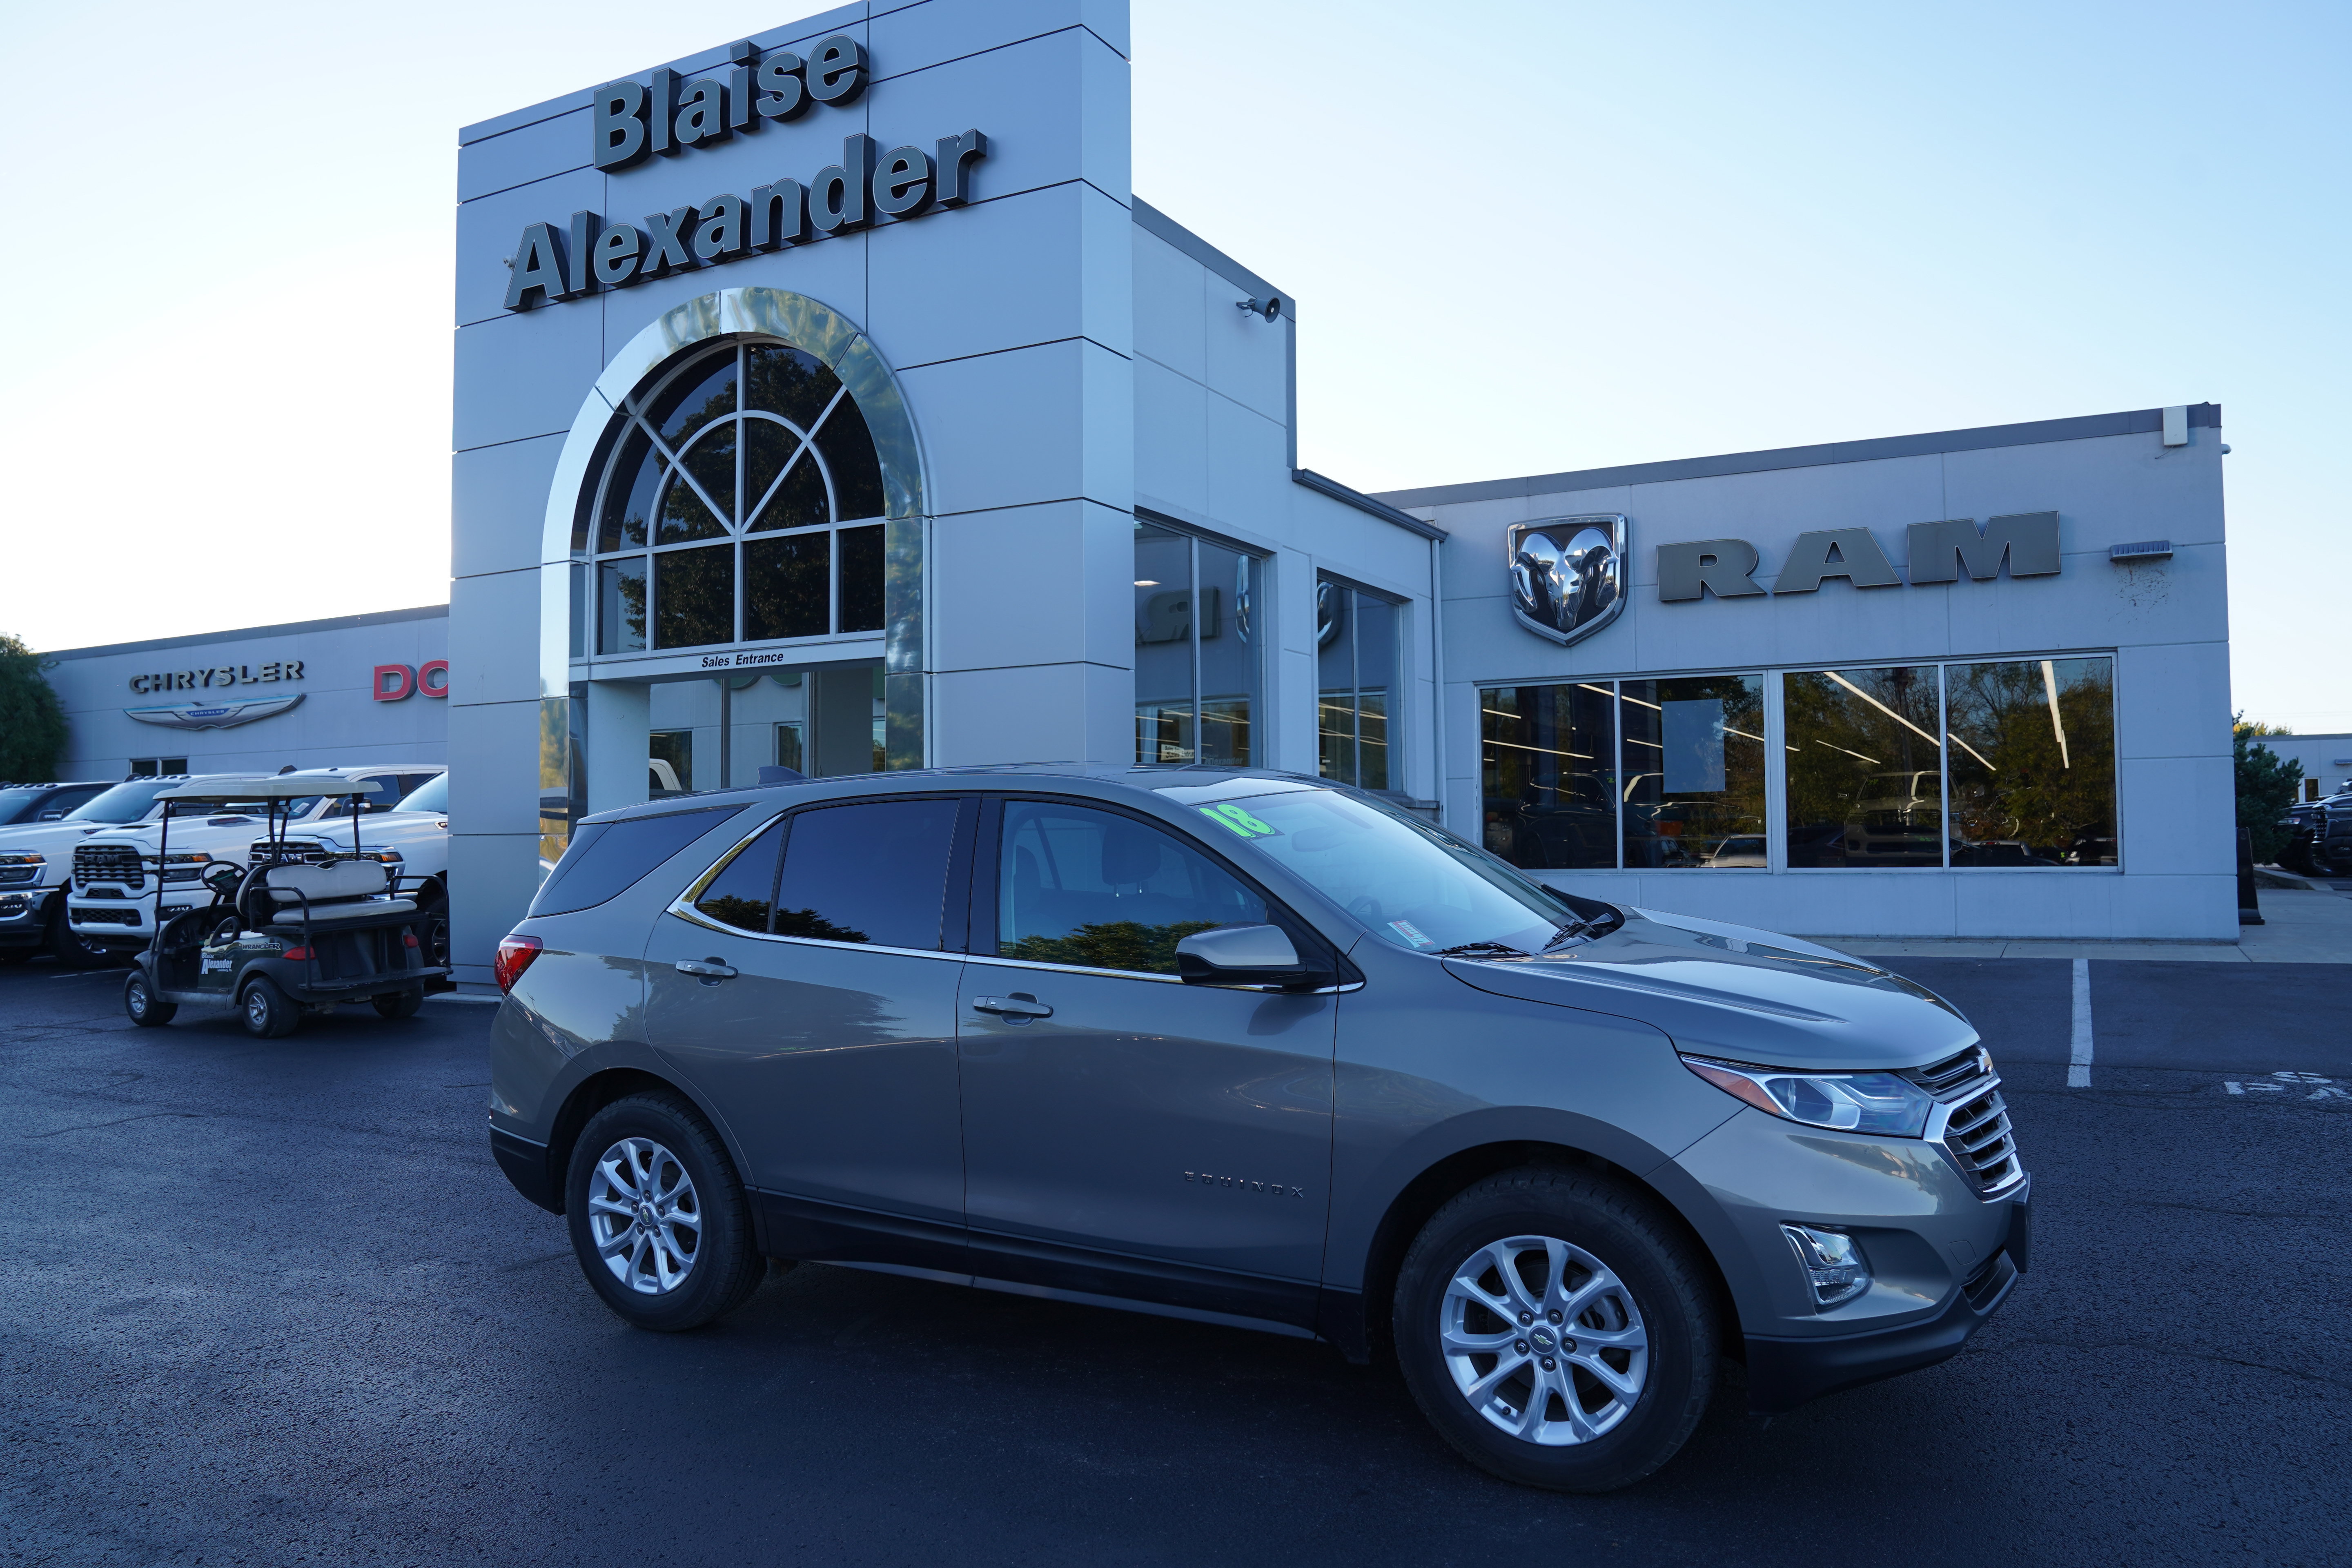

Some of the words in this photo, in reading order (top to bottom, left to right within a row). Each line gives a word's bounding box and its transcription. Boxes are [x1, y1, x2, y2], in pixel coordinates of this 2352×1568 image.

[593, 34, 868, 173] Blaise
[503, 129, 987, 312] Alexander
[1656, 510, 2061, 602] RAM
[129, 660, 305, 693] CHRYSLER
[702, 656, 729, 667] Sales
[736, 653, 784, 665] Entrance
[1198, 804, 1276, 837] 18
[201, 958, 233, 974] Alexander
[1184, 1171, 1304, 1198] EQUINOX
